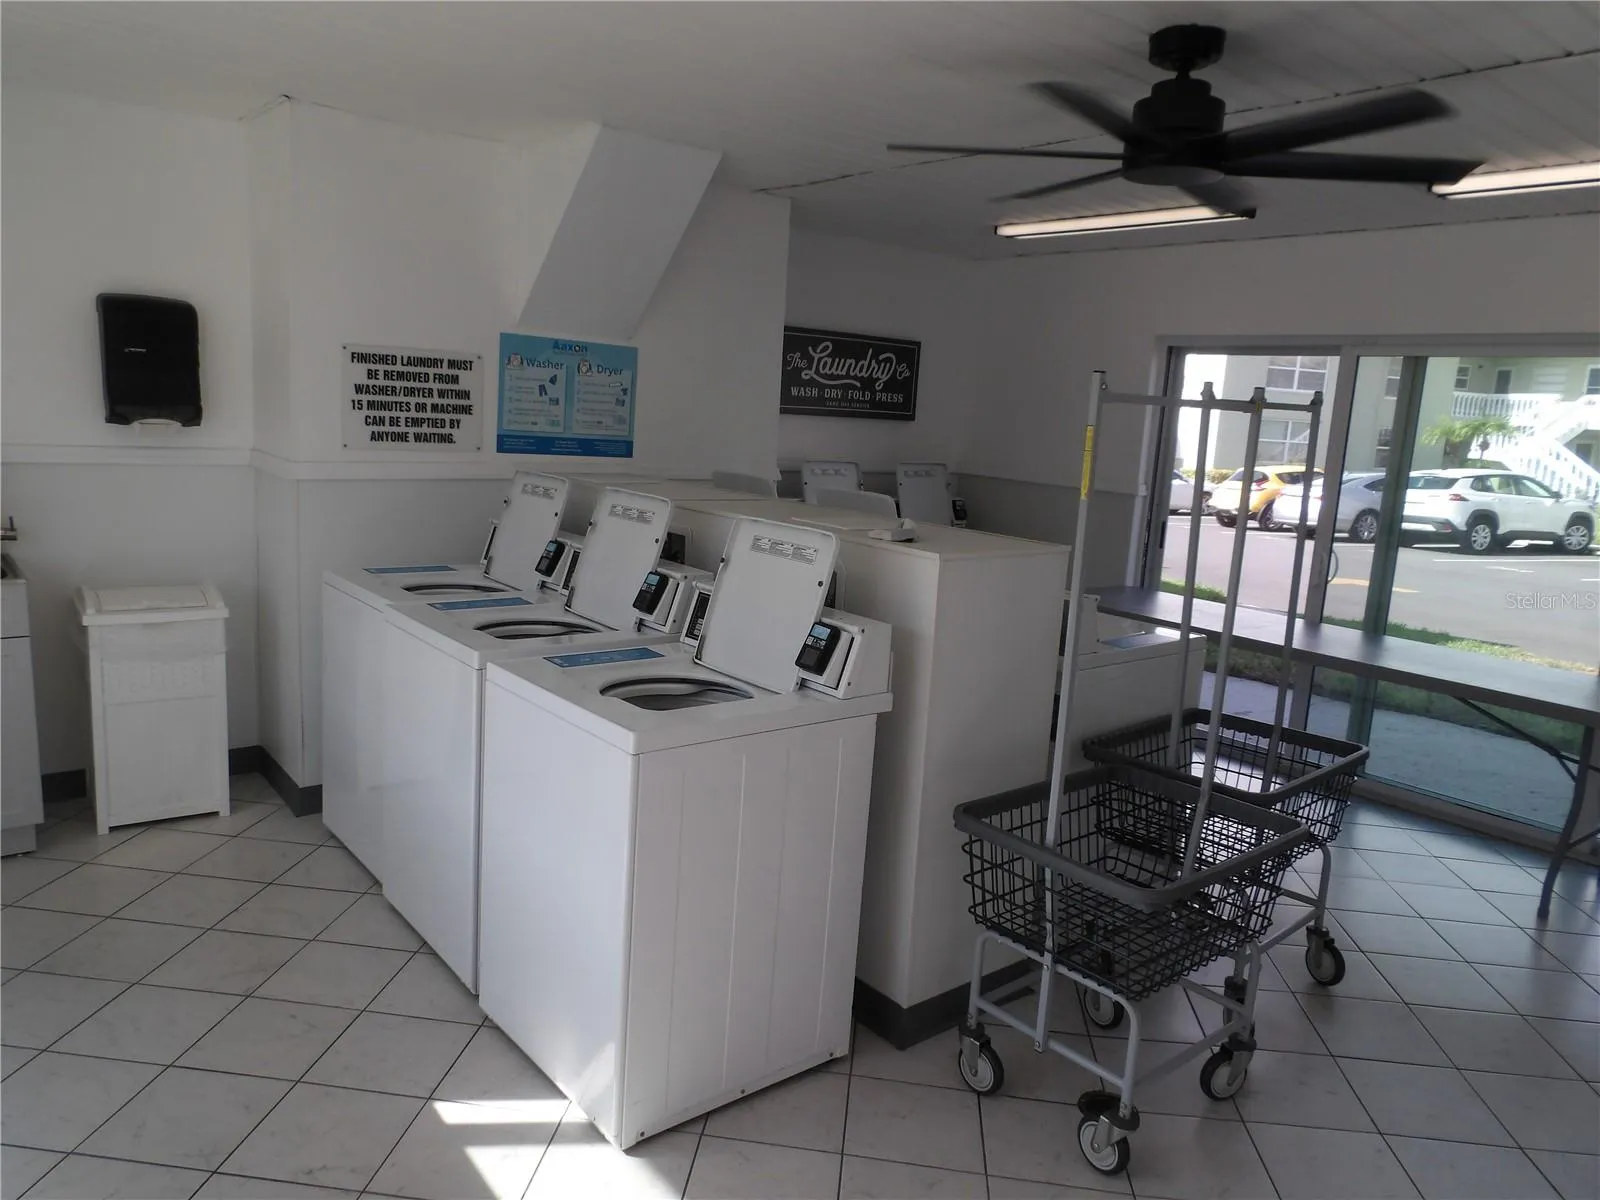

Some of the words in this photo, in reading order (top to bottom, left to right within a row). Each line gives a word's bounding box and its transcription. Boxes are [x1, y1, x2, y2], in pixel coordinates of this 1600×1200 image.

[351, 352, 397, 366] FINISHED
[401, 355, 444, 369] LAUNDRY
[447, 359, 474, 371] MUST
[525, 358, 564, 370] Washer
[787, 352, 809, 370] The
[801, 341, 896, 390] Laundry
[367, 369, 380, 380] BE
[383, 370, 430, 383] REMOVED
[433, 373, 460, 385] FROM
[597, 364, 624, 376] Dryer
[354, 383, 434, 399] WASHER/DRYER
[437, 388, 471, 400] WITHIN
[791, 386, 819, 398] WASH
[824, 388, 843, 399] DRY
[848, 390, 871, 401] FOLD
[876, 392, 904, 403] PRESS
[351, 399, 363, 411] 15
[367, 400, 411, 413] MINUTES
[414, 402, 428, 413] OR
[431, 403, 473, 415] MACHINE
[364, 415, 386, 427] CAN
[389, 416, 401, 428] BE
[405, 417, 446, 429] EMPTIED
[449, 419, 461, 430] BY
[370, 431, 410, 443] ANYONE
[413, 432, 456, 444] WAITING.
